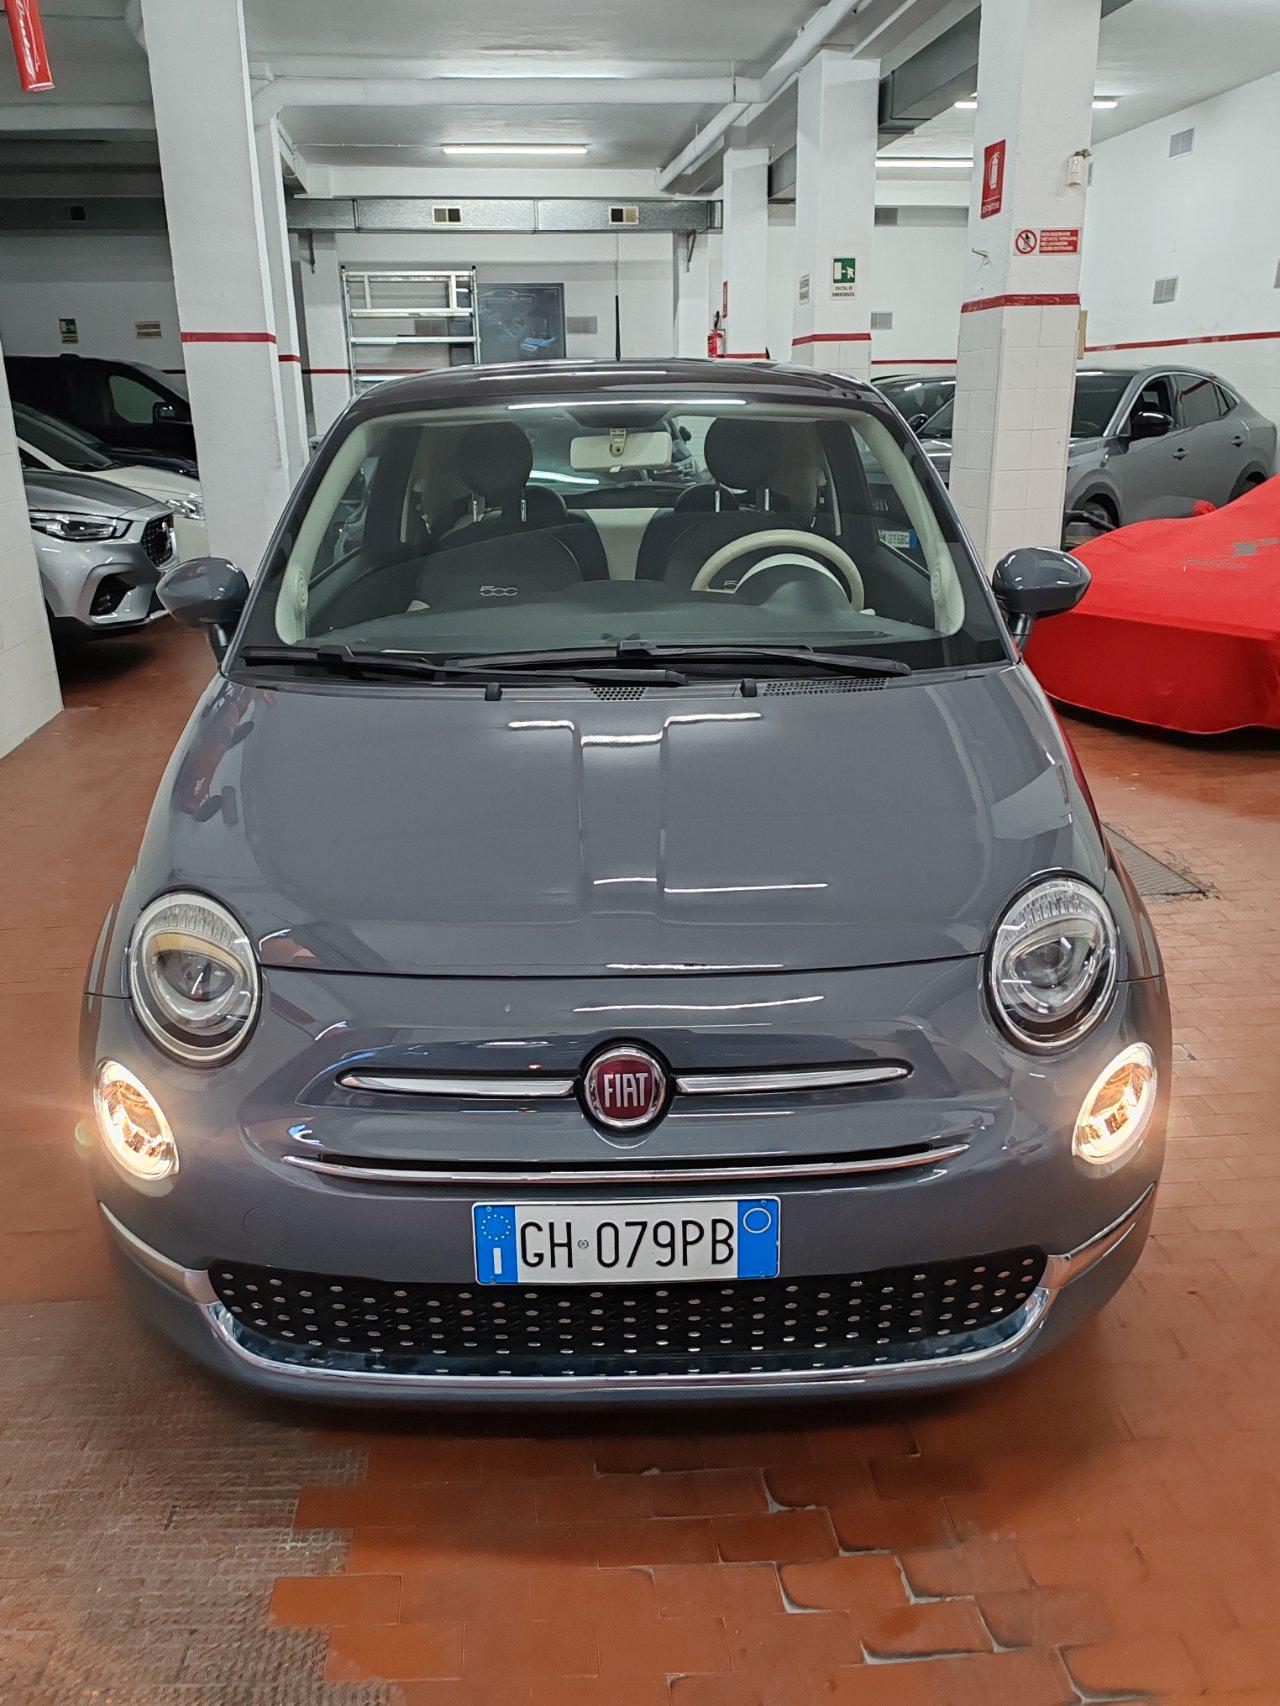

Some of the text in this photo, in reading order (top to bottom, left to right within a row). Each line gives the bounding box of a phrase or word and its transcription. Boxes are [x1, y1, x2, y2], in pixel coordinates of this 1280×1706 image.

[480, 585, 518, 597] 500
[603, 1072, 649, 1108] FIAT
[520, 1218, 735, 1268] GH 079PB
[493, 1247, 503, 1275] I
